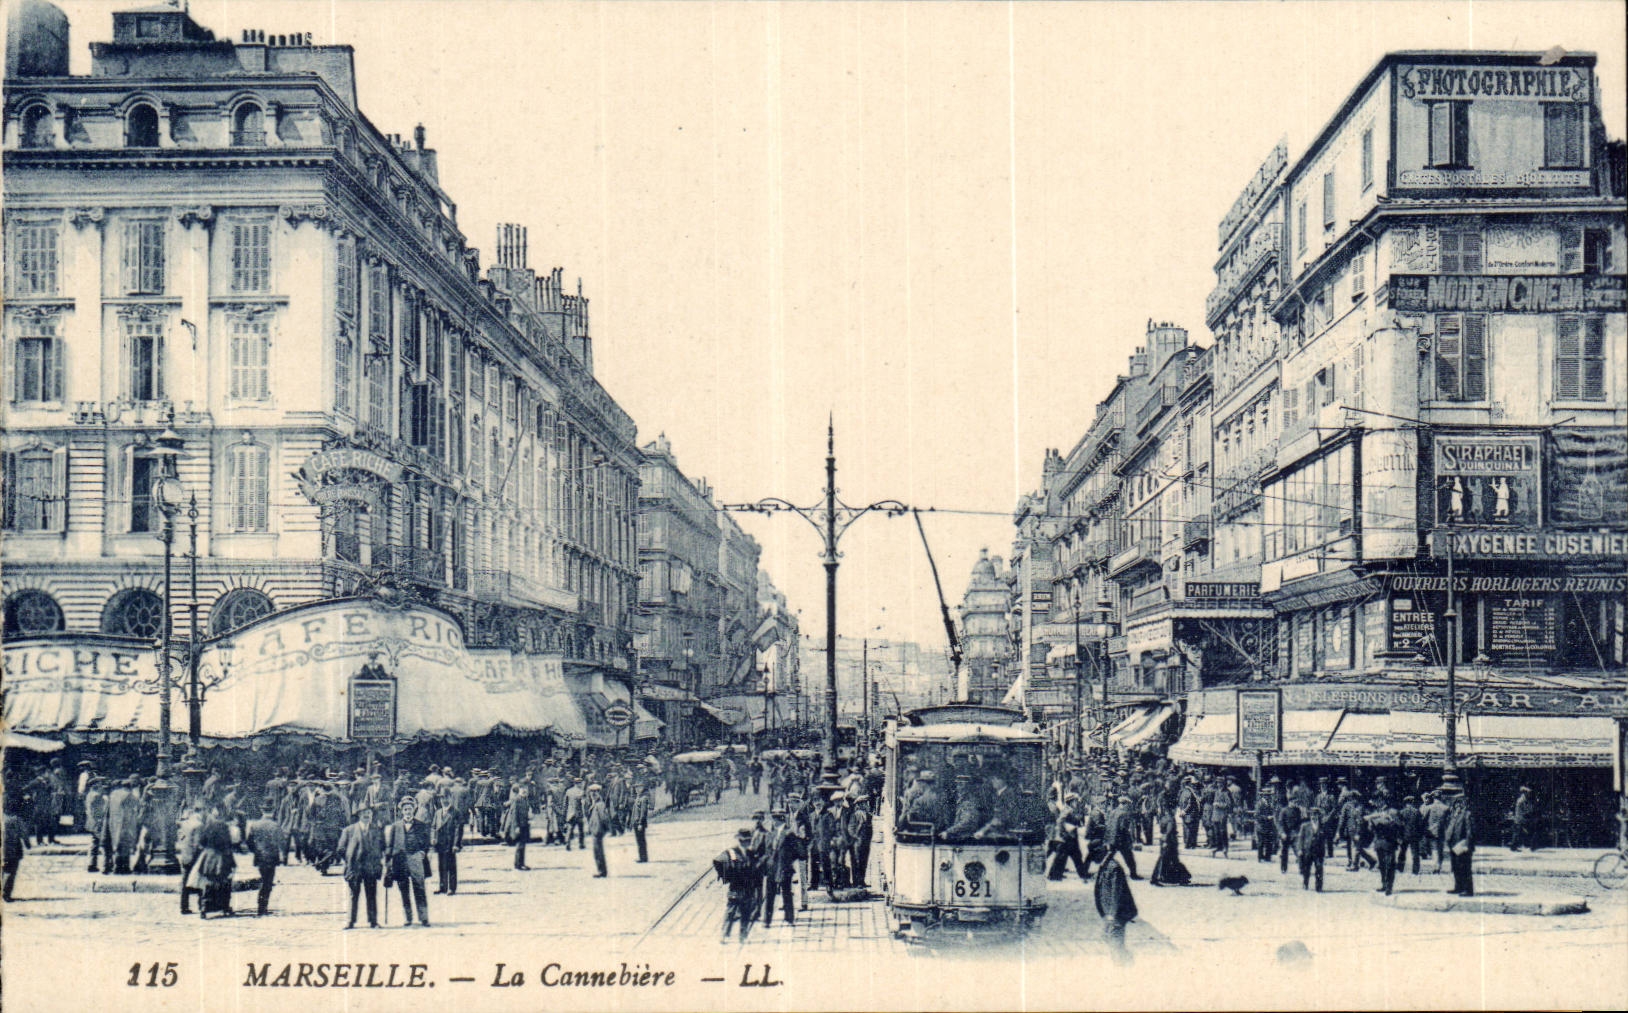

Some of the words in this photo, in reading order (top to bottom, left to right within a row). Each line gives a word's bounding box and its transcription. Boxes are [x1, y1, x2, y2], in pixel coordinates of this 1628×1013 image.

[1417, 68, 1572, 97] PHOTOGRAPHIE
[1461, 445, 1532, 470] RAPHAEL
[352, 450, 395, 482] RICHE
[1460, 461, 1520, 473] QUINQUINA
[1186, 583, 1259, 597] PARFUMERIE
[1470, 576, 1562, 592] HORLOGERS
[1563, 577, 1626, 592] REUNIS
[1503, 599, 1544, 608] TARIF
[1304, 689, 1387, 704] TELEPHONE
[954, 880, 993, 898] 621
